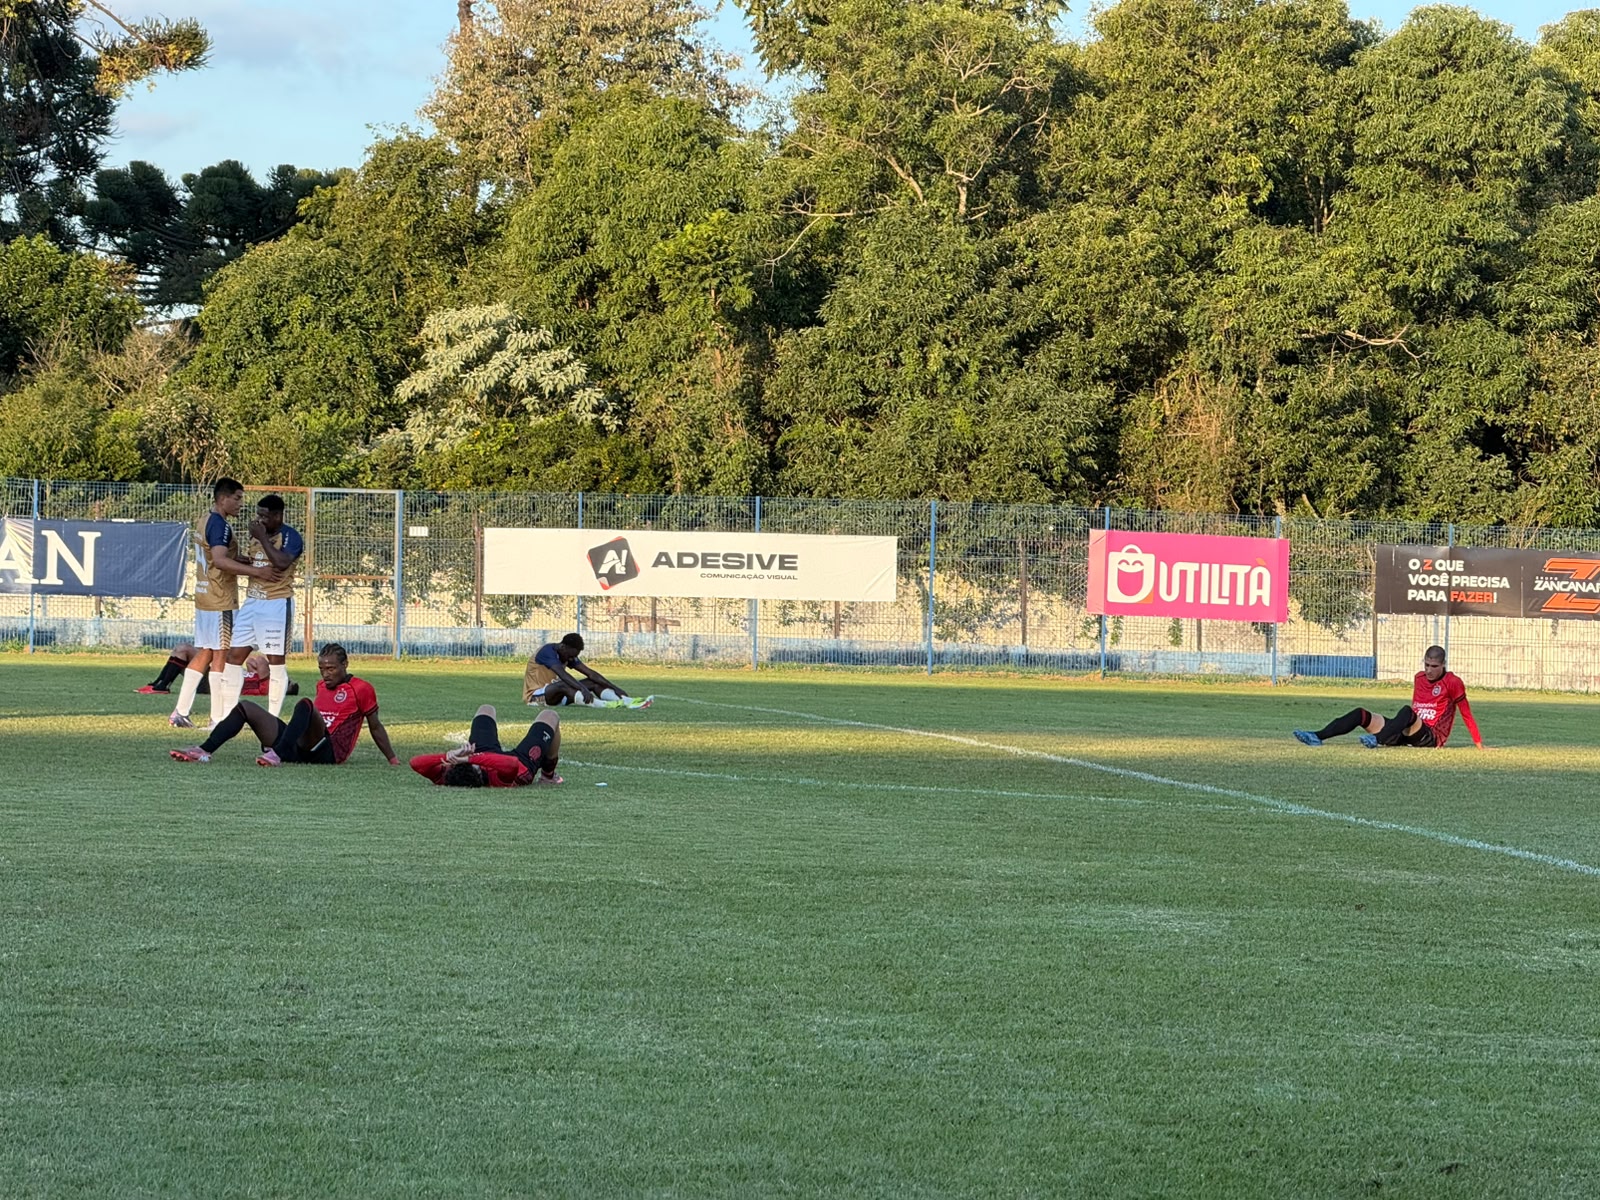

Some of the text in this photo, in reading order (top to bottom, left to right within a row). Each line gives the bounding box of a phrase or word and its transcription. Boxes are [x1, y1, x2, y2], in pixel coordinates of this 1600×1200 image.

[651, 551, 798, 571] ADESIVE
[1408, 558, 1465, 572] O Z QUE
[700, 571, 765, 580] COMUNICAÇÃO
[1408, 572, 1510, 589] VOCÊ PRECISA
[1407, 589, 1497, 604] PARA FAZER!
